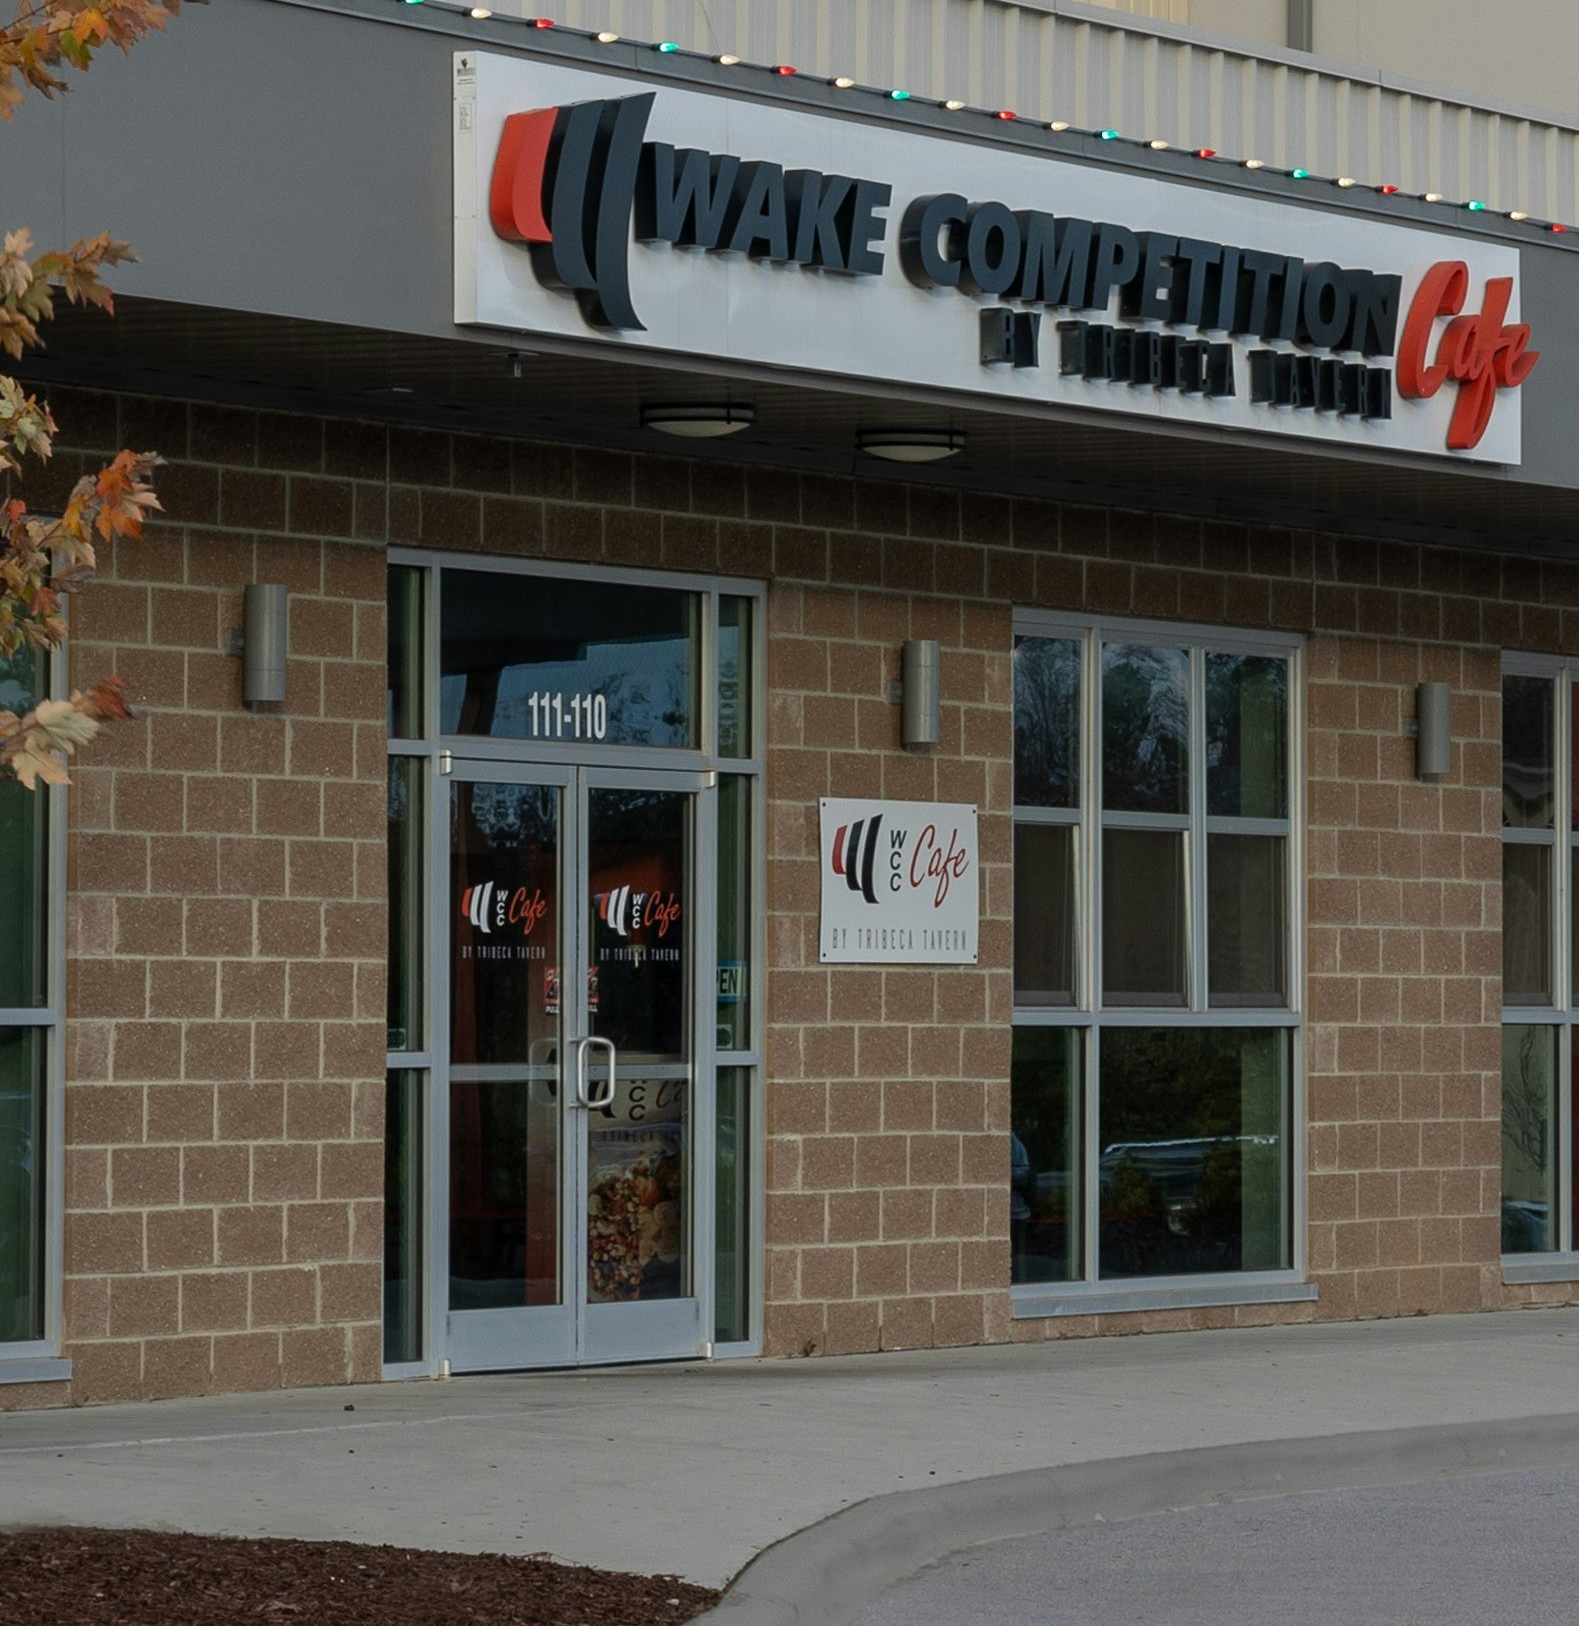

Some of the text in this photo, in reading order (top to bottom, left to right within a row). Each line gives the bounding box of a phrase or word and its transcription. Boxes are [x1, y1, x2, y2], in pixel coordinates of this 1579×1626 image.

[634, 141, 1403, 358] WAKE COMPETITION
[980, 306, 1393, 420] BY TRIBECA TAVERN
[1396, 260, 1542, 451] Cafe
[528, 691, 606, 740] 111-110
[909, 823, 970, 909] Cafe
[508, 886, 548, 936] Cafe
[643, 890, 682, 938] Cafe
[832, 927, 967, 952] BY TRIBECA TAVERN
